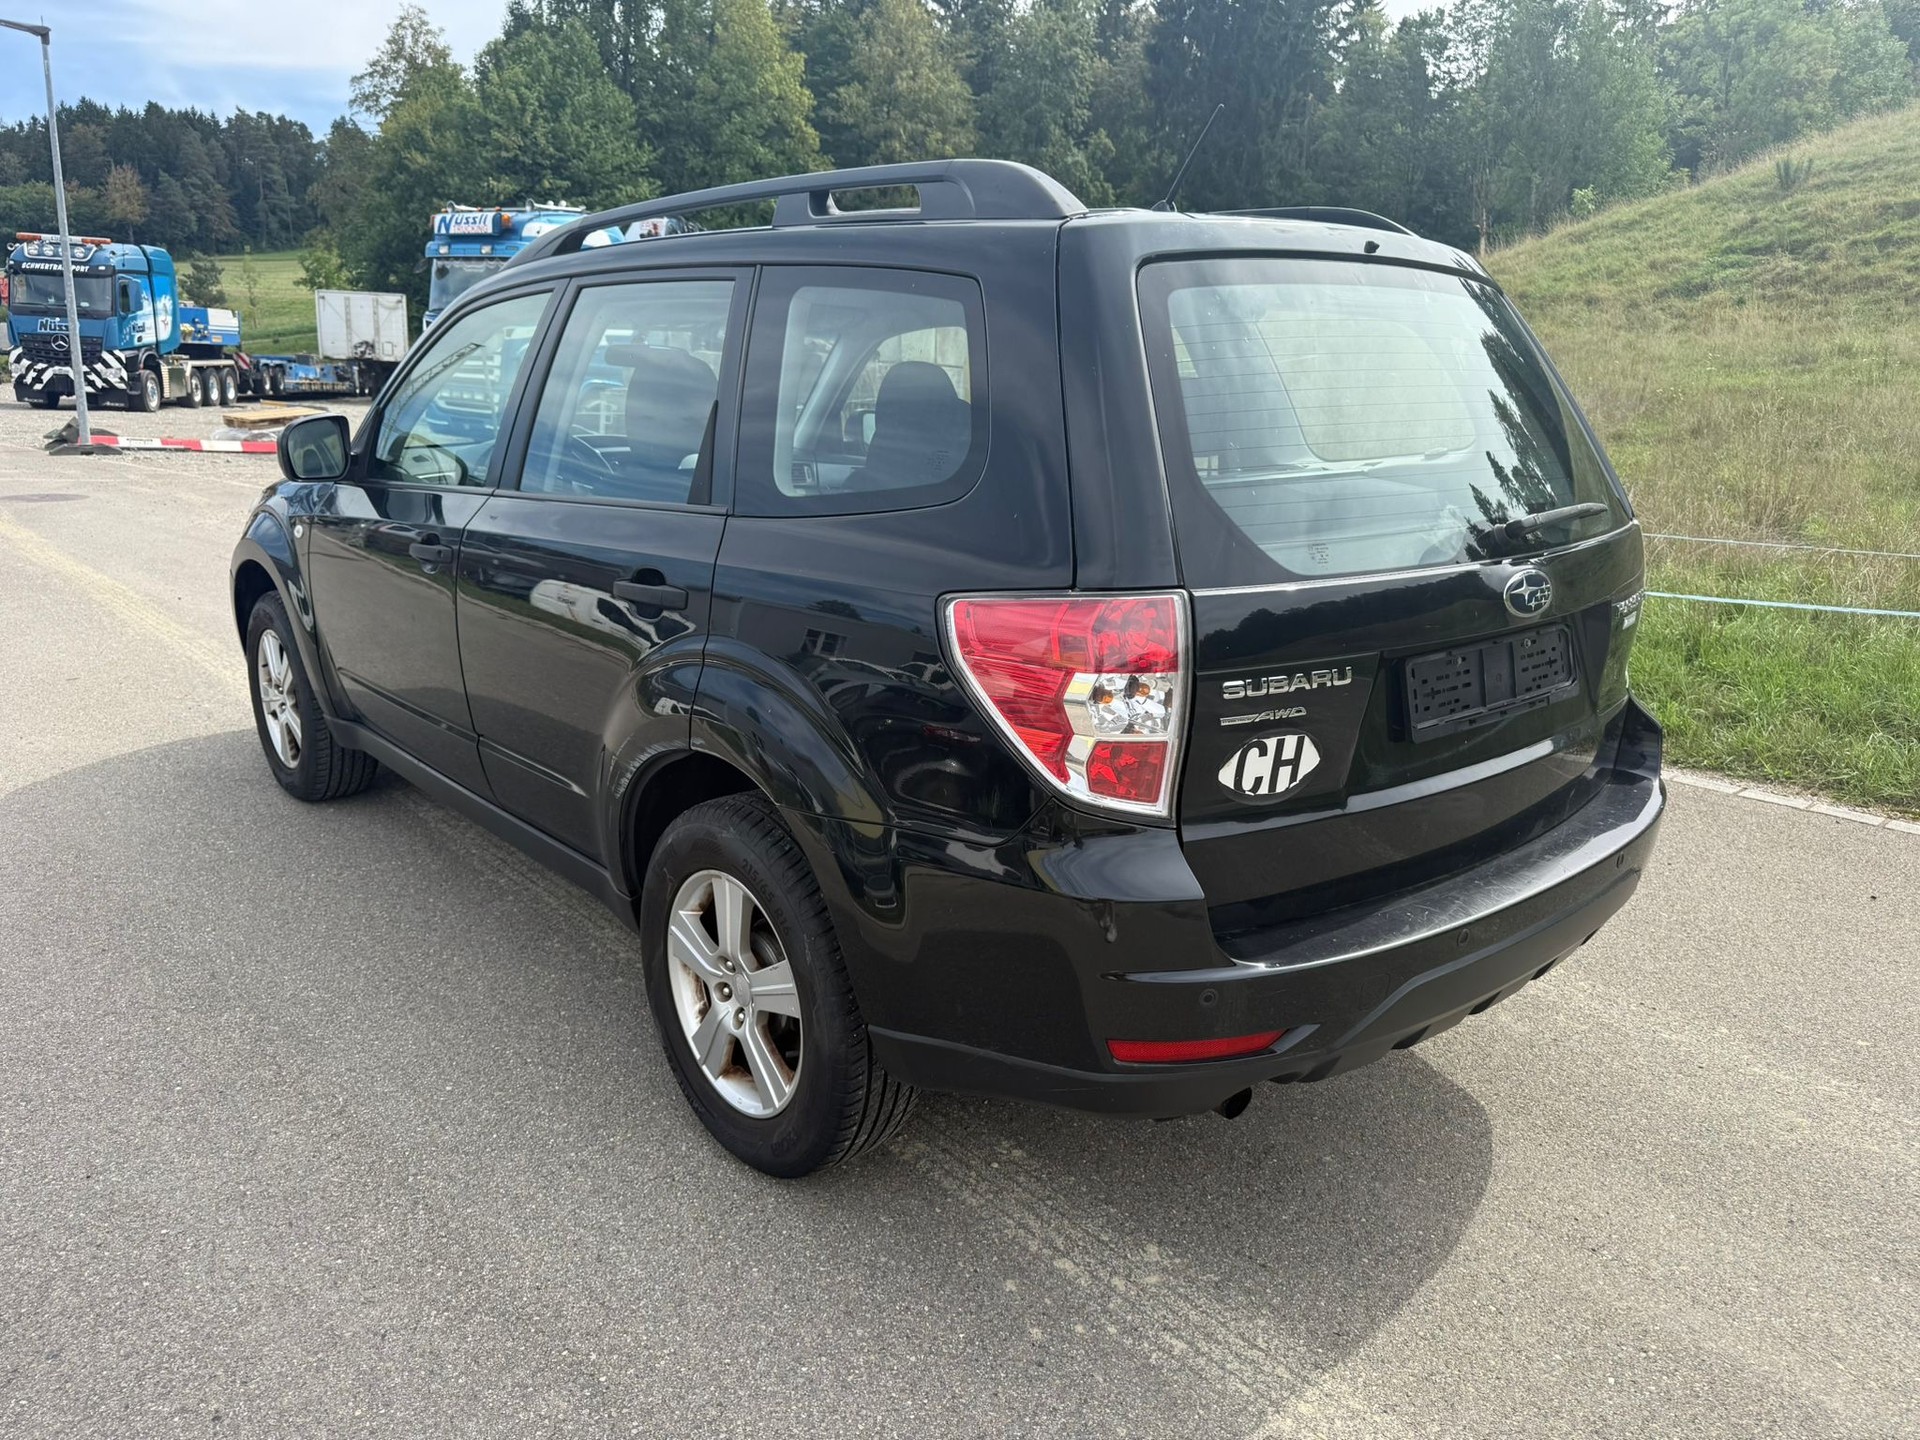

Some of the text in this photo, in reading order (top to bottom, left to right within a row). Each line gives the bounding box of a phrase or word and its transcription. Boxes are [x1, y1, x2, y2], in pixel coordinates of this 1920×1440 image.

[21, 262, 90, 273] SCHWERTRAPORT
[1222, 666, 1353, 700] SUBARU
[1253, 706, 1307, 723] AWD
[1233, 735, 1306, 794] CH
